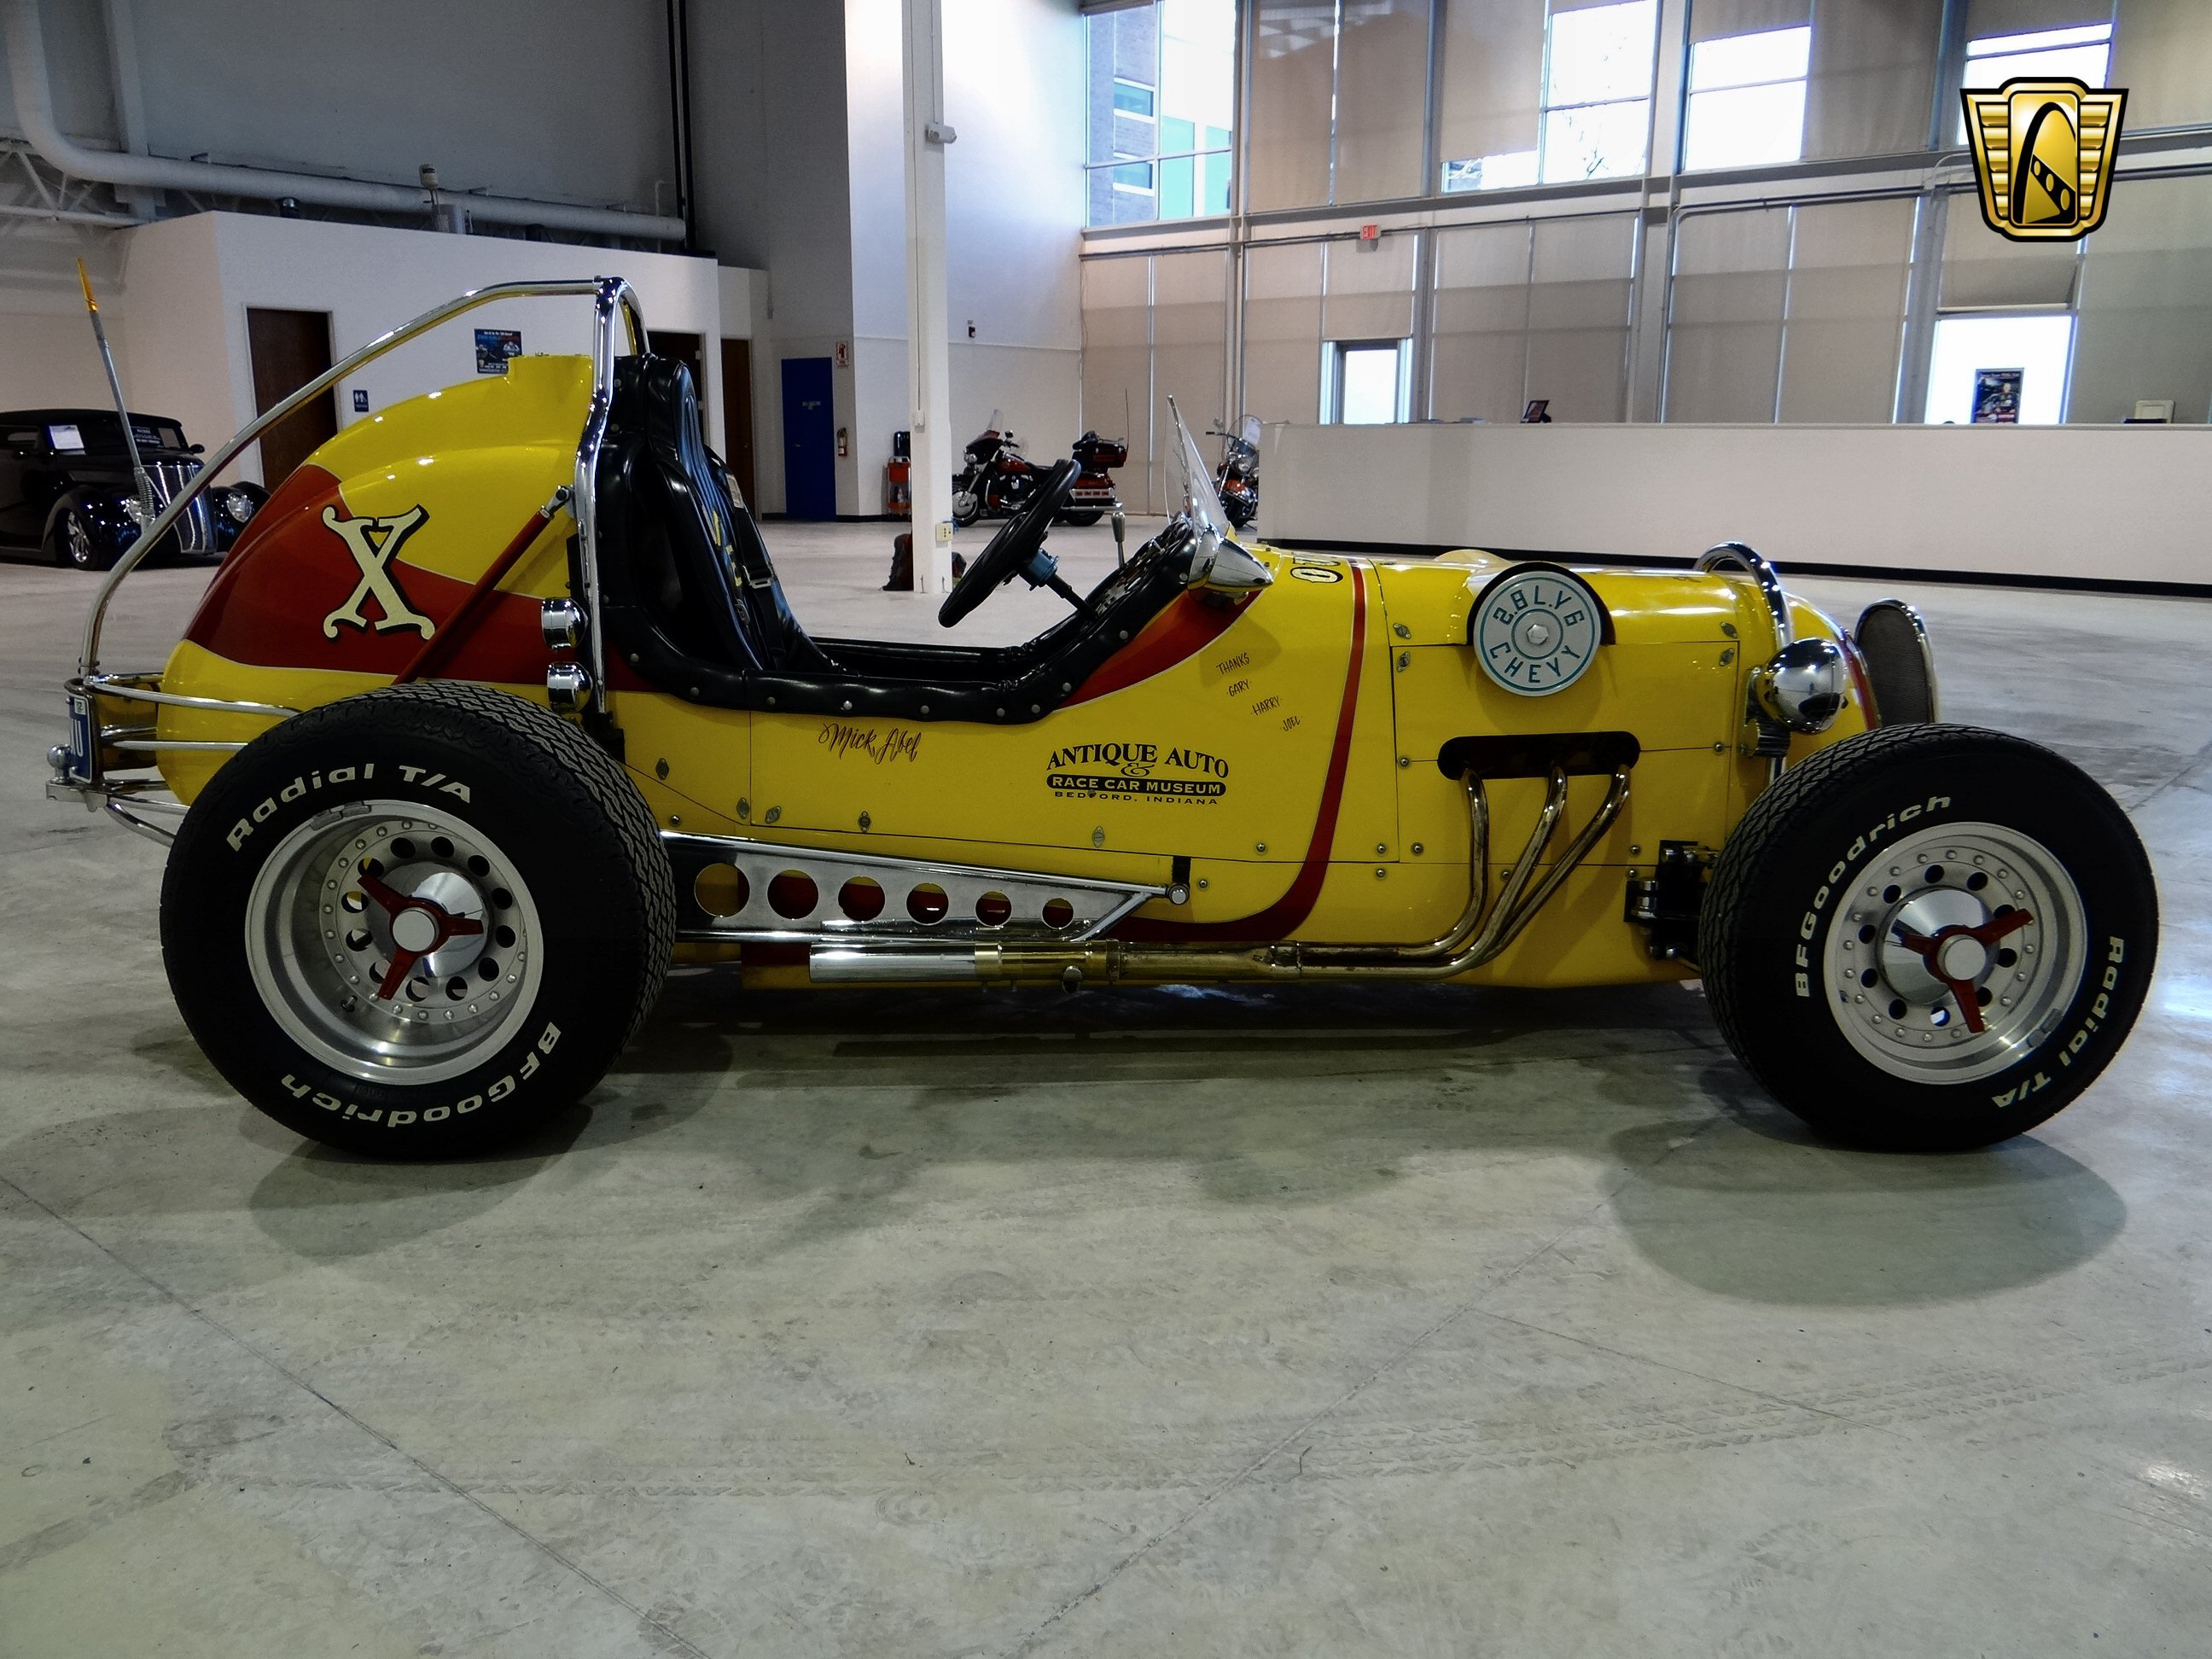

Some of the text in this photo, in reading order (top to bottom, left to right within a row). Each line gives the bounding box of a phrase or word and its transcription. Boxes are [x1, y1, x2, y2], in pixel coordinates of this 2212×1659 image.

[323, 504, 436, 642] X
[1216, 652, 1250, 674] THANKS
[1489, 641, 1580, 684] CHEVY
[1046, 742, 1229, 778] ANTIQUE AUTO
[1121, 763, 1155, 777] &
[1052, 776, 1221, 795] RACE CAR MUSEUM
[1146, 795, 1219, 806] INDIANA
[226, 763, 470, 852] Radial T/A
[1795, 796, 1951, 998] BFGoodrich
[1991, 936, 2125, 1108] Radial T/A
[281, 1022, 562, 1128] BFGoodrich
